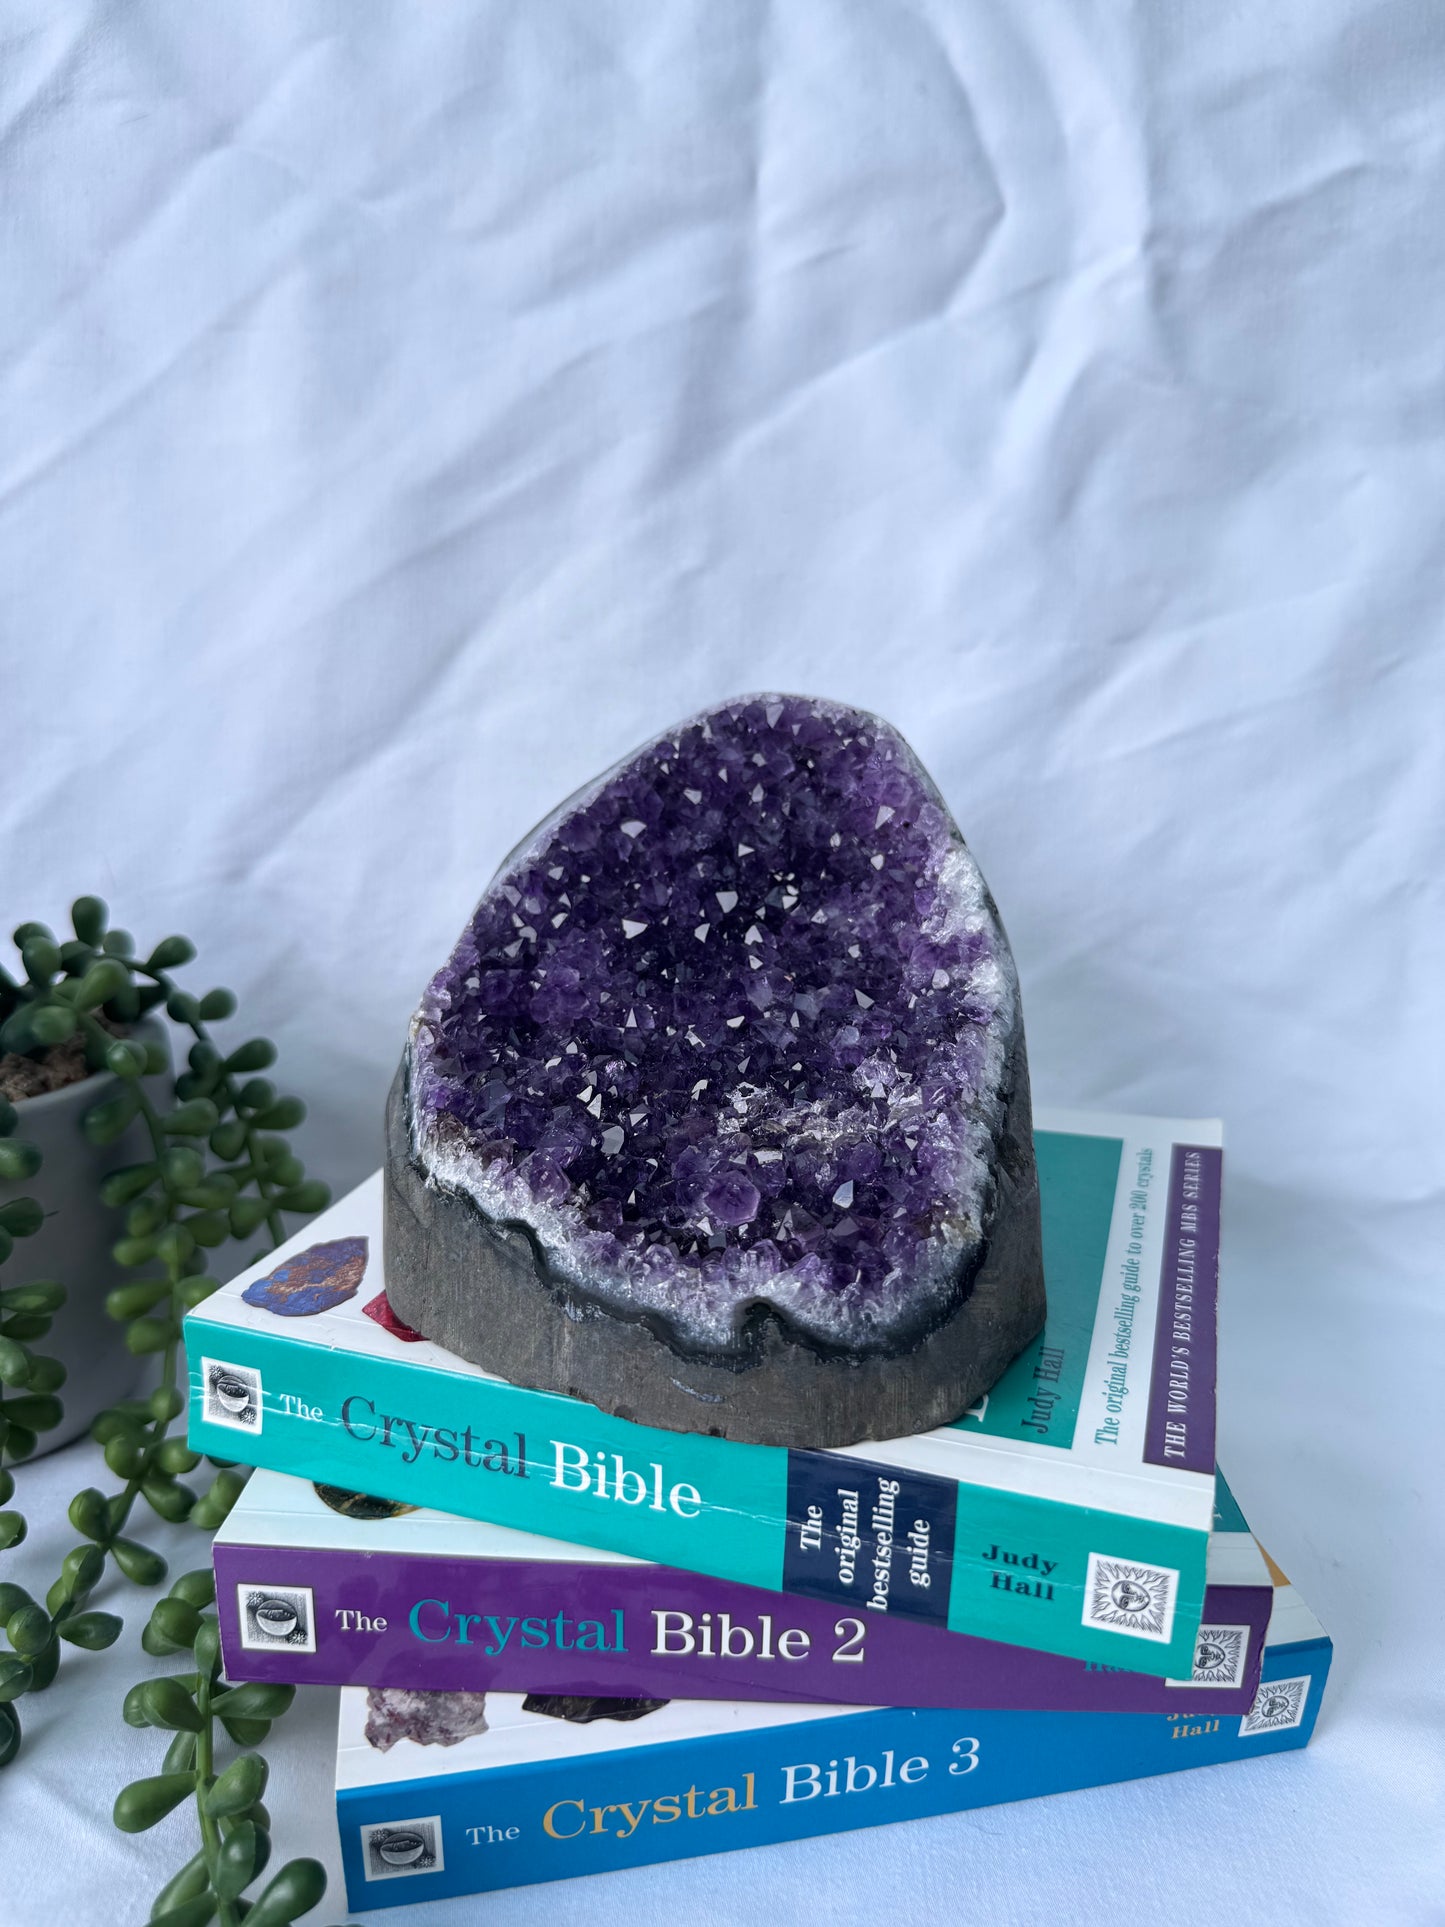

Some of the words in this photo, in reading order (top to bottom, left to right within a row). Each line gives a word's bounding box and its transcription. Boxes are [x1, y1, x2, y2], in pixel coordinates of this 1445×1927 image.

[1135, 1148, 1154, 1188] crystals
[1182, 1151, 1202, 1199] SERIES
[1129, 1189, 1148, 1211] 200
[1180, 1203, 1199, 1233] MBS
[1125, 1242, 1142, 1254] to
[1130, 1213, 1146, 1239] over
[1120, 1257, 1142, 1294] guide
[1172, 1237, 1197, 1342] BESTSELLING
[1107, 1292, 1140, 1359] bestselling
[1033, 1345, 1065, 1384] Hall
[1102, 1360, 1129, 1413] original
[1168, 1346, 1191, 1416] WORLD'S
[1021, 1387, 1062, 1435] Judy
[1094, 1416, 1121, 1445] The
[280, 1393, 324, 1423] The
[341, 1395, 531, 1480] Crystal
[549, 1440, 703, 1519] Bible
[1164, 1420, 1187, 1458] THE
[800, 1504, 824, 1551] The
[834, 1488, 862, 1586] original
[866, 1476, 901, 1614] bestselling
[906, 1518, 932, 1590] guide
[982, 1544, 1060, 1577] Judy
[990, 1571, 1056, 1602] Hall
[335, 1609, 389, 1634] The
[408, 1599, 630, 1657] Crystal
[650, 1610, 811, 1661] Bible
[832, 1616, 867, 1663] 2
[1171, 1719, 1220, 1740] Hall
[465, 1821, 521, 1847] The
[542, 1772, 759, 1842] Crystal
[779, 1750, 930, 1805] Bible
[948, 1736, 981, 1776] 3
